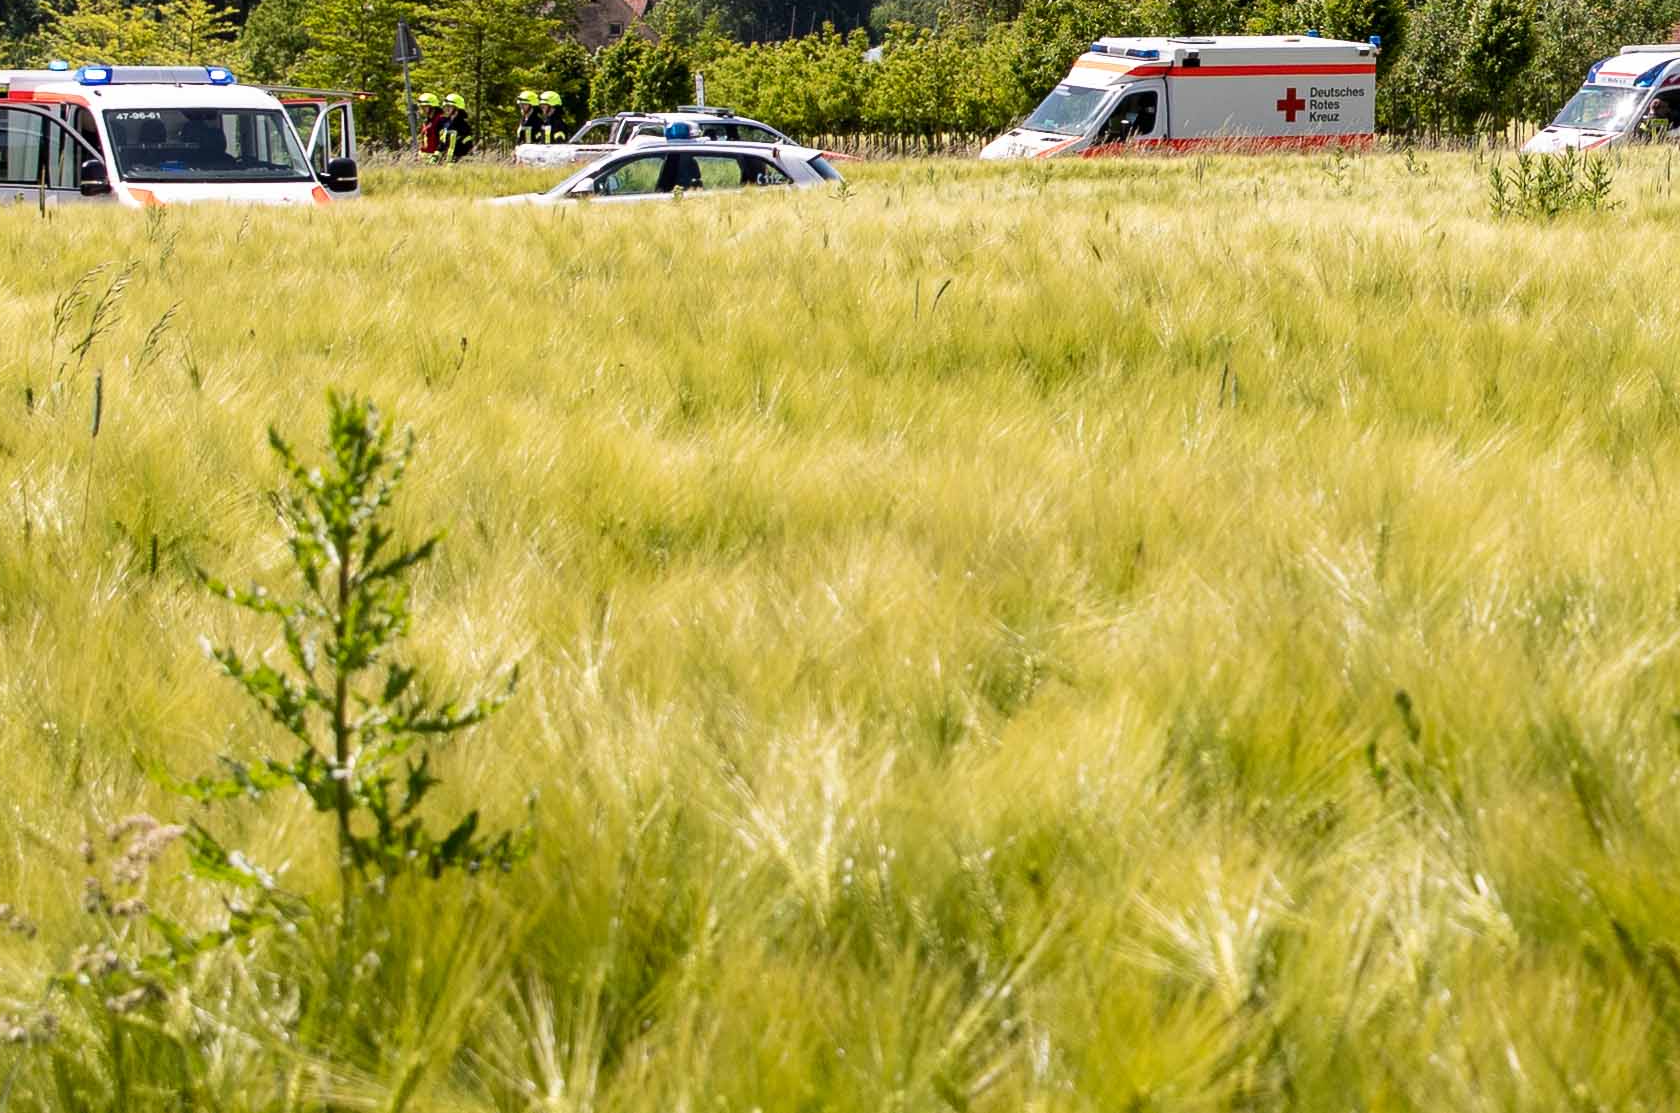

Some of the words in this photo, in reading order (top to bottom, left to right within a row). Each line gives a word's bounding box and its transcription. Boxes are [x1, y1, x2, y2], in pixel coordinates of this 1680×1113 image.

[1310, 87, 1365, 98] Deutsches
[1310, 99, 1340, 110] Rotes
[1309, 111, 1339, 122] Kreuz
